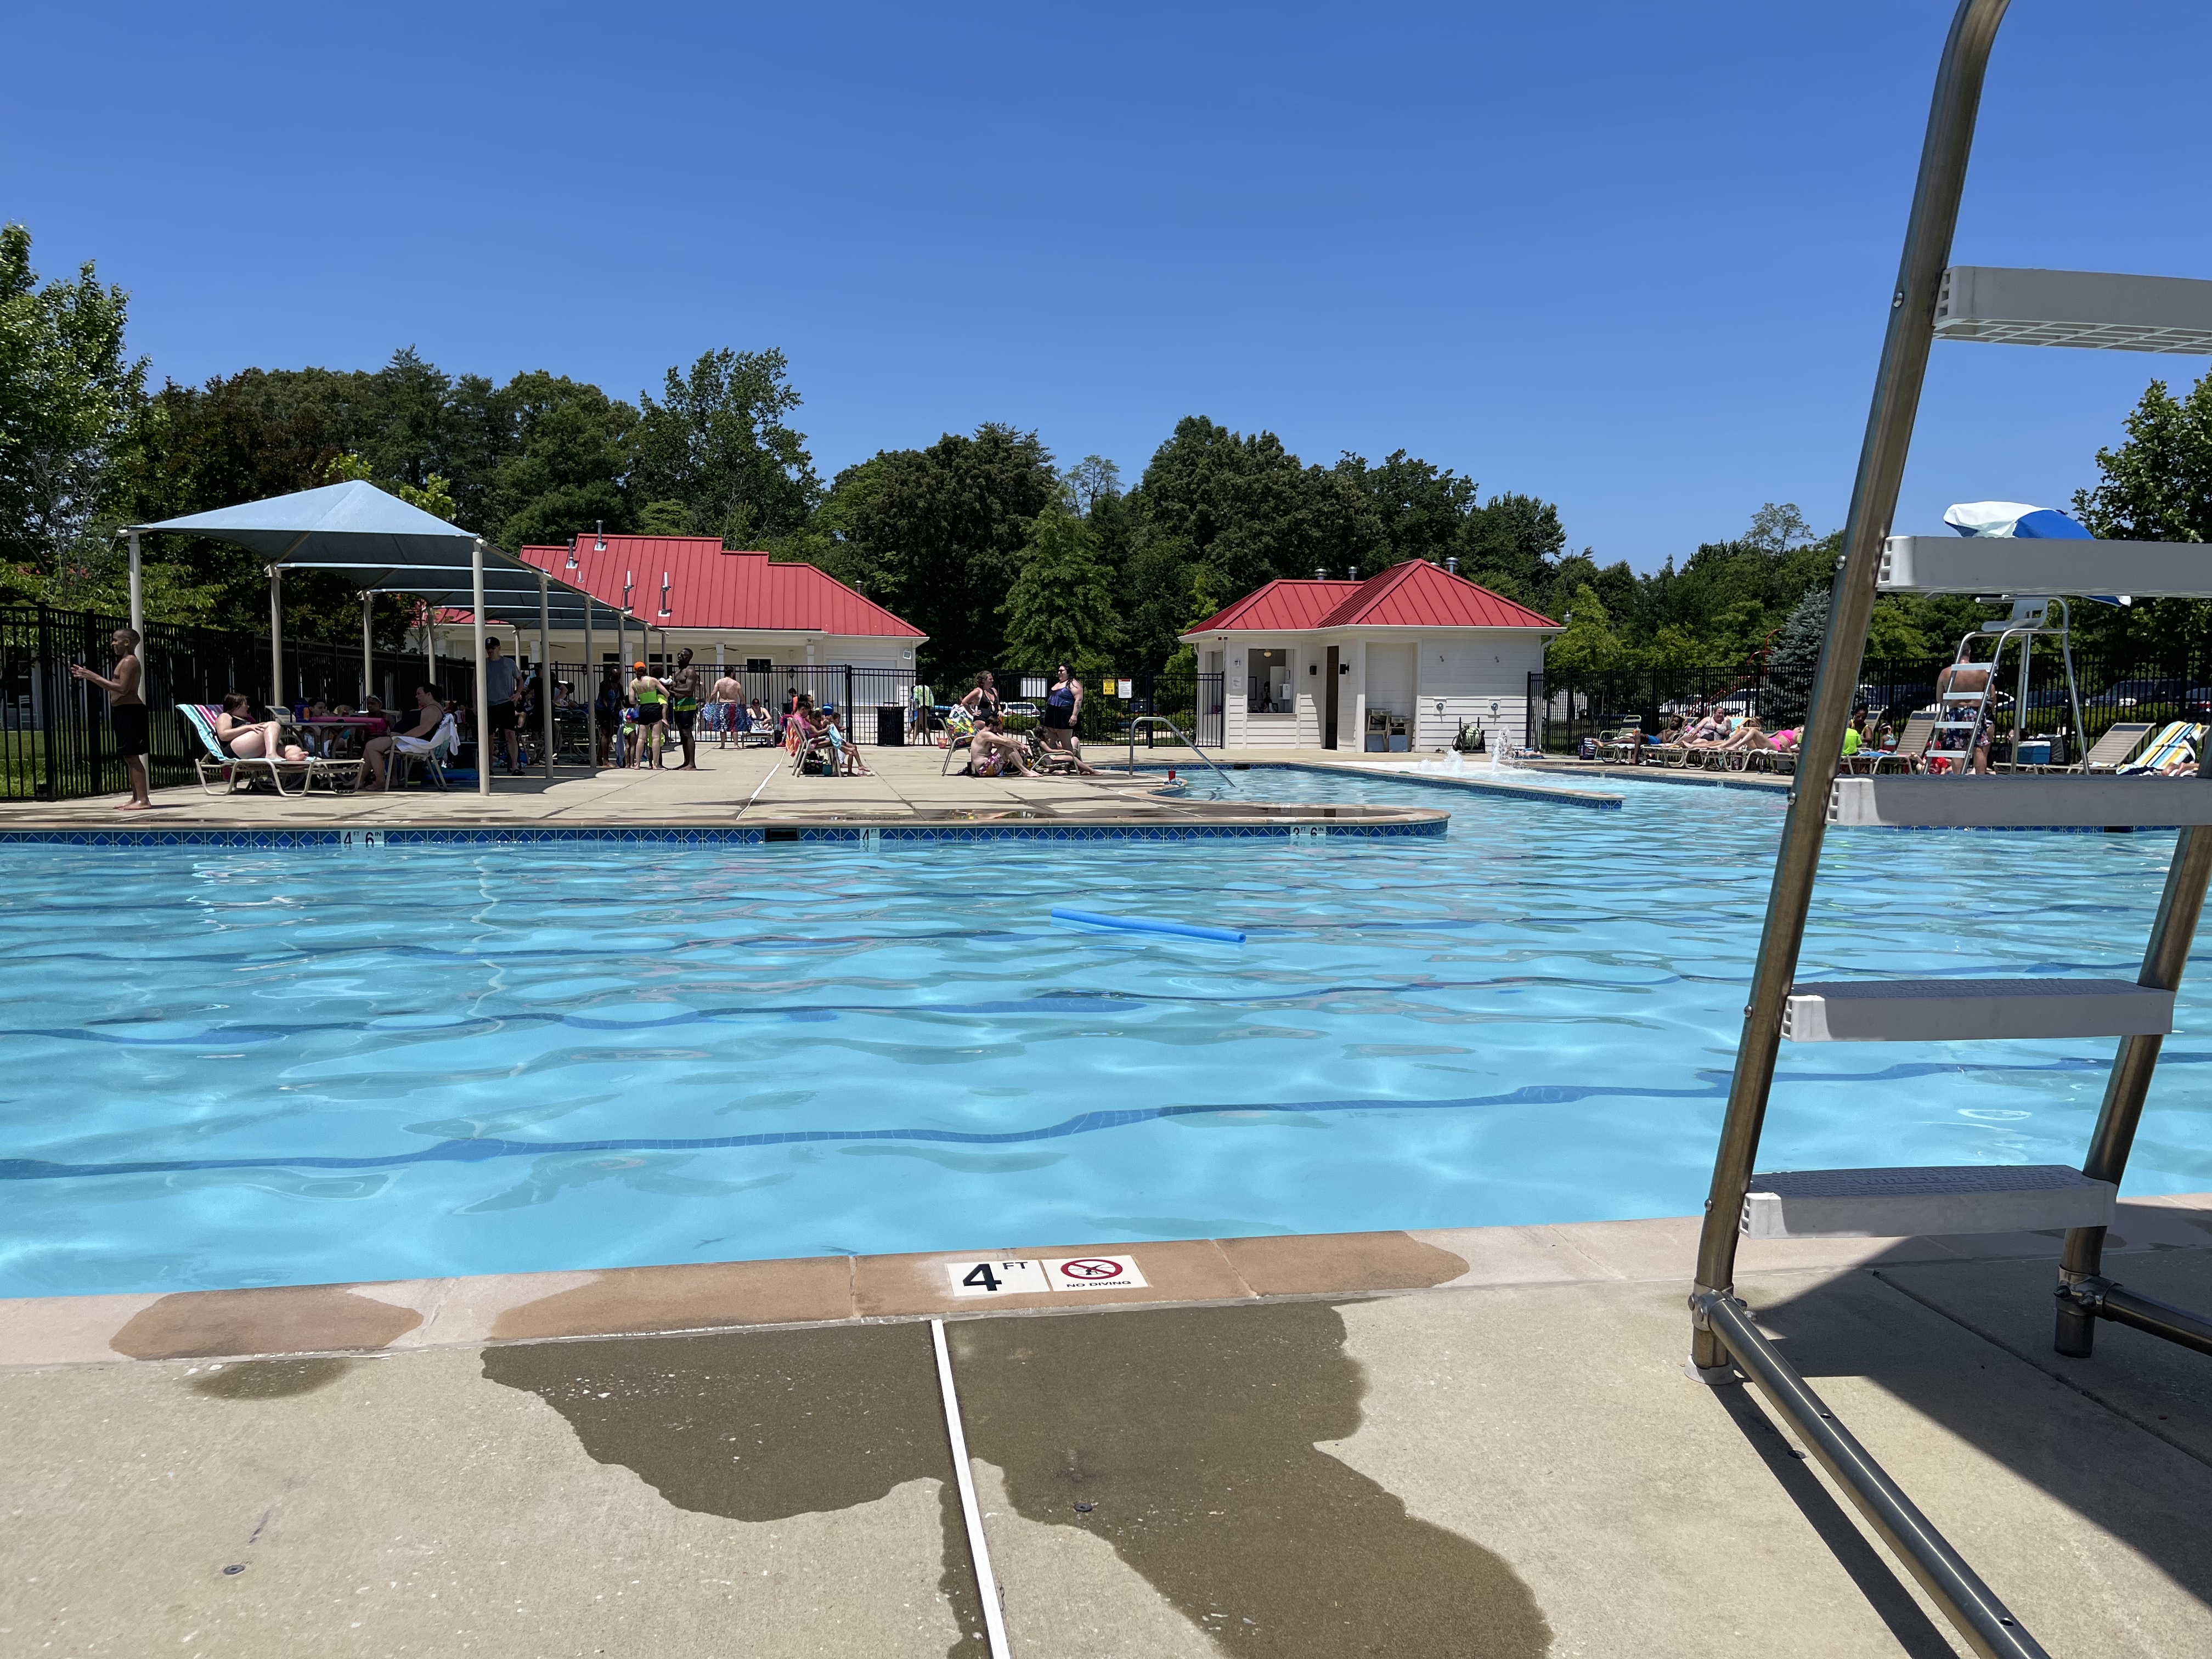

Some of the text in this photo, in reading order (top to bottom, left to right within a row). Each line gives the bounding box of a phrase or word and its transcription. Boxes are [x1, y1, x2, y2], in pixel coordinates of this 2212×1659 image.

[343, 831, 353, 844] 4
[365, 831, 374, 844] 6
[862, 828, 869, 840] 4
[1311, 827, 1318, 836] 6
[962, 1261, 1028, 1291] 4 FT
